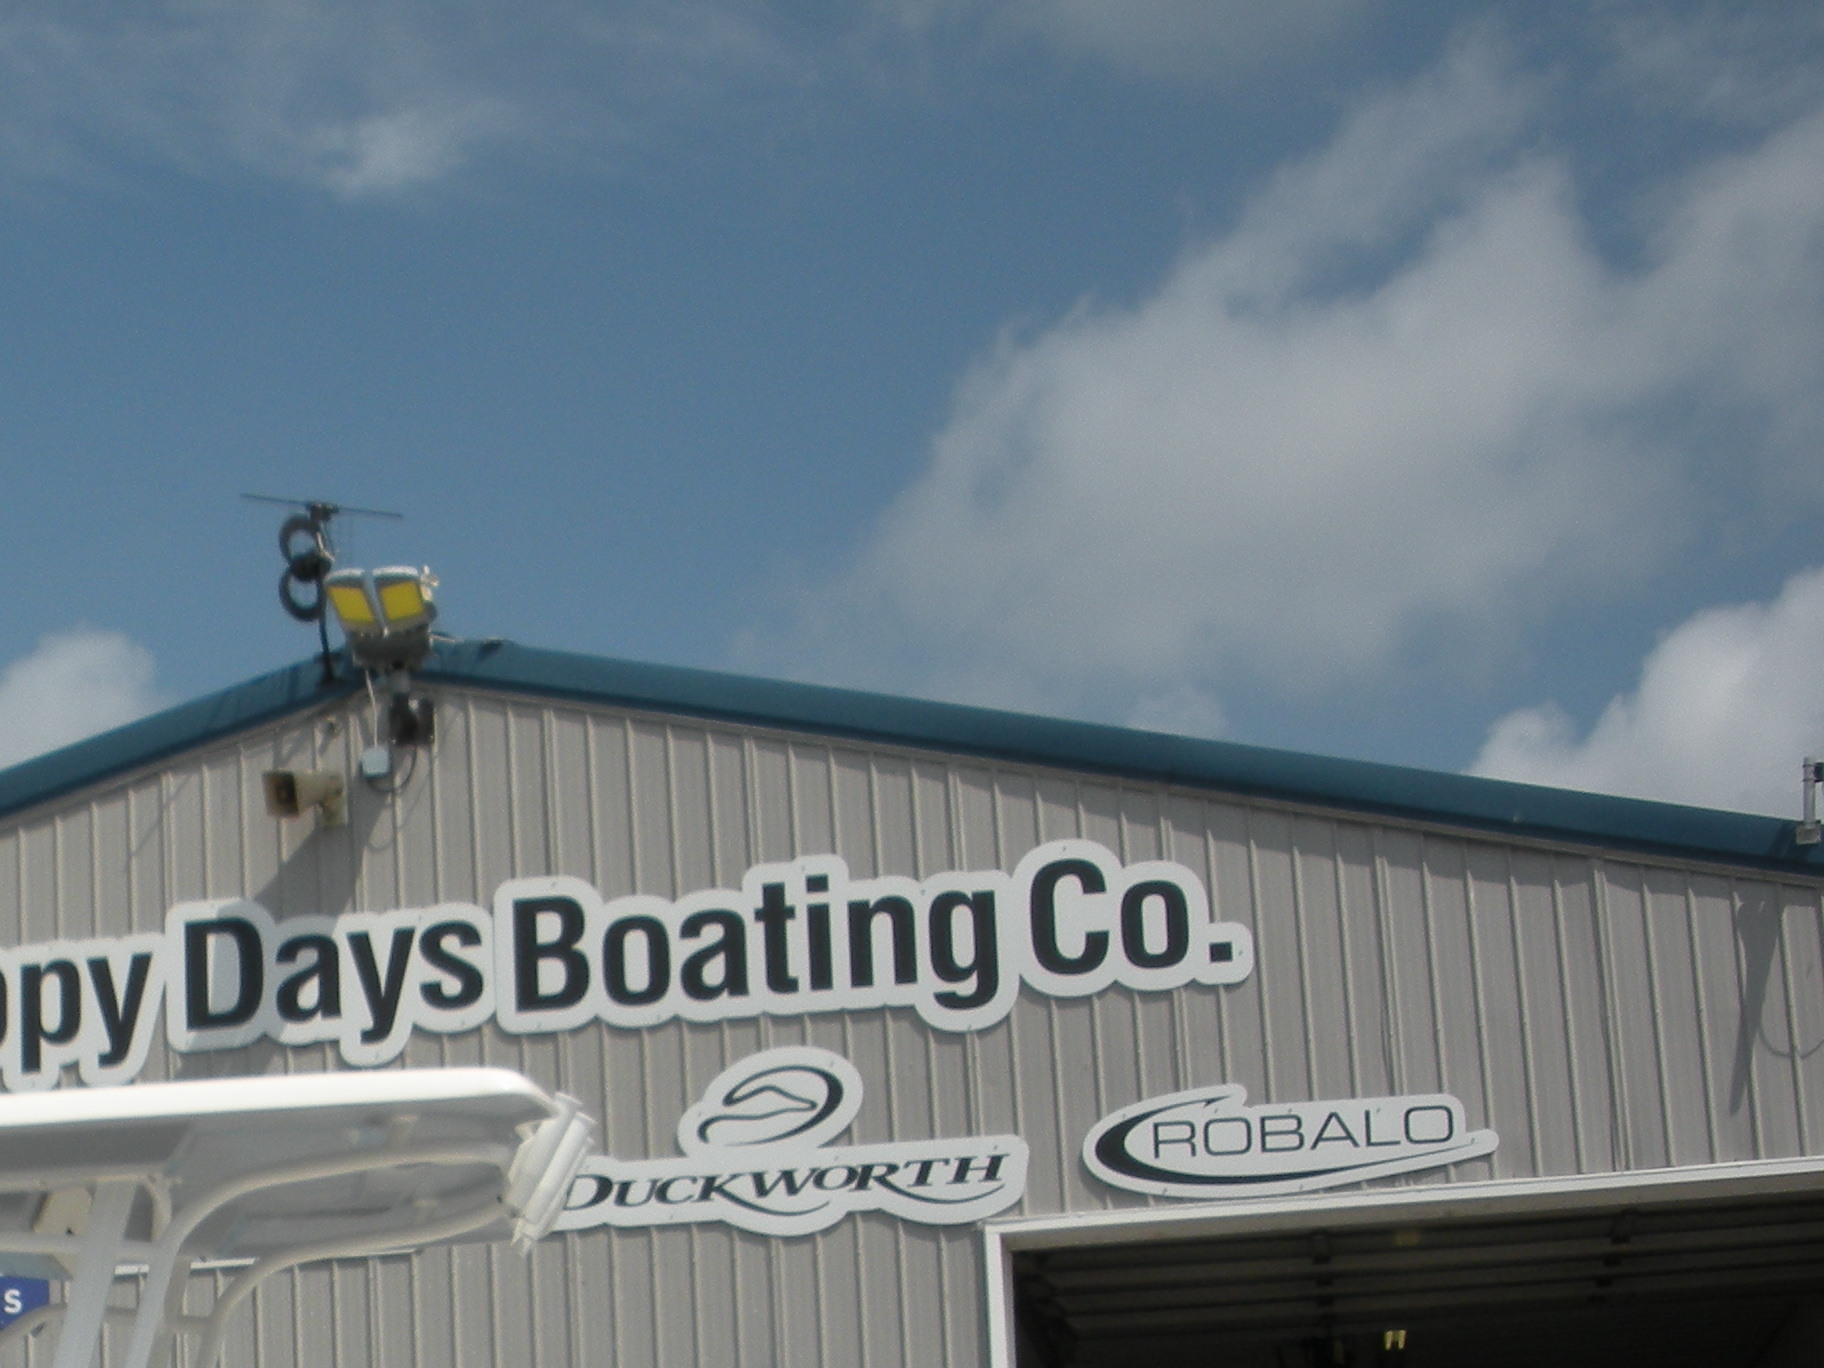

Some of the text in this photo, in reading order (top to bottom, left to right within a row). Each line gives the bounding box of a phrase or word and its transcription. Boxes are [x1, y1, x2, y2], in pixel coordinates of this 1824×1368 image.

[184, 915, 485, 1045] Days
[512, 873, 996, 1011] Boating
[1030, 858, 1234, 976] Co.
[1152, 1105, 1454, 1159] ROBALO
[564, 1153, 1010, 1216] DUCKWORTH
